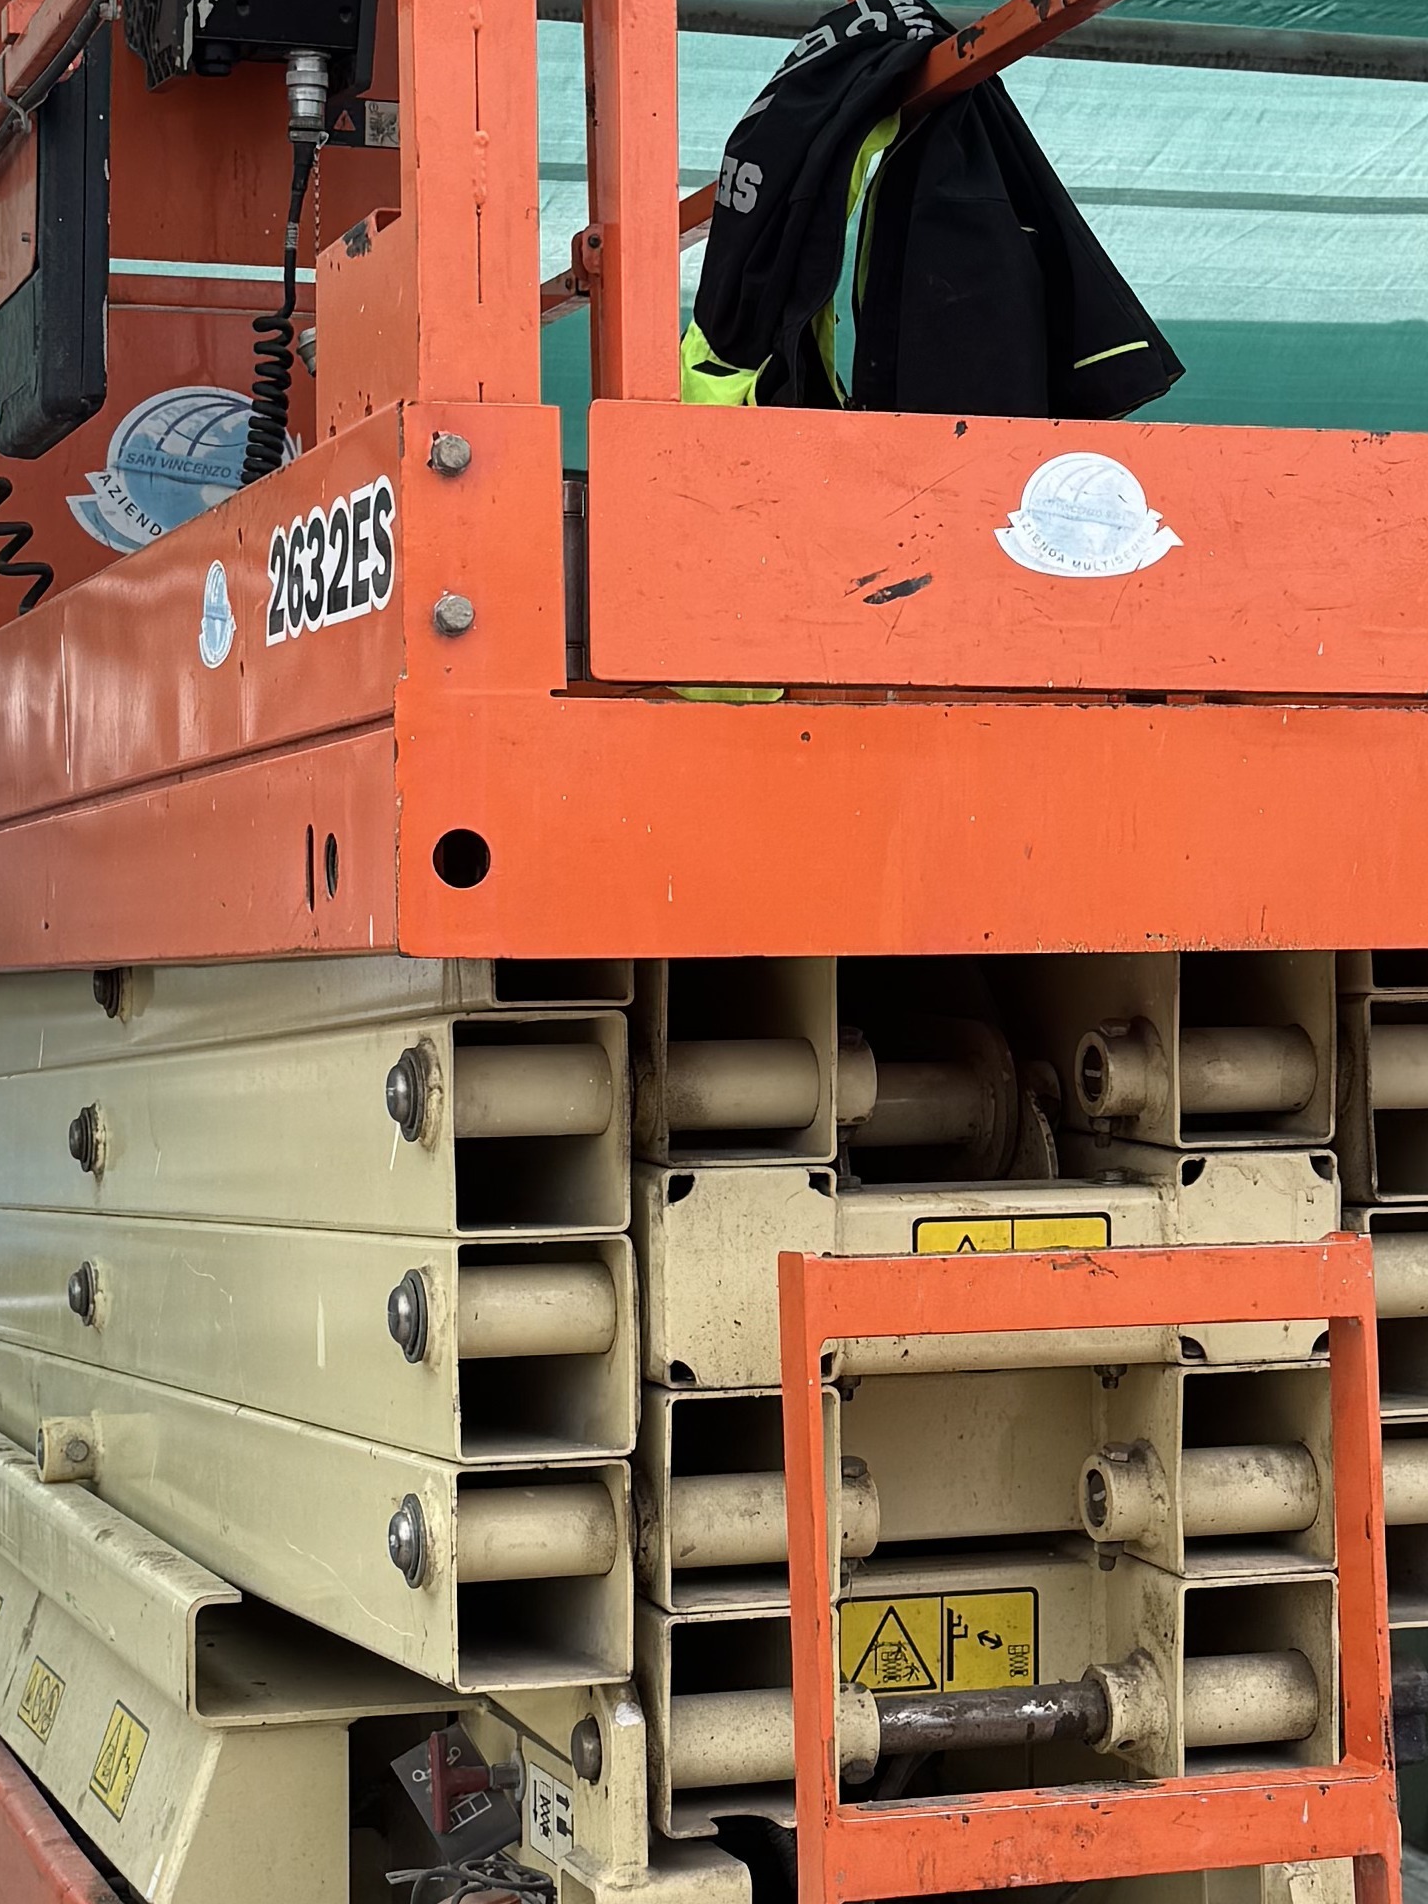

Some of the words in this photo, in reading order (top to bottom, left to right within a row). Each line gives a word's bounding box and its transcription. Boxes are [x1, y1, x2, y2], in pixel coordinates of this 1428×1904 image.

[126, 452, 157, 466] SAN
[160, 459, 232, 480] VINCENZO
[269, 486, 392, 637] 2632ES
